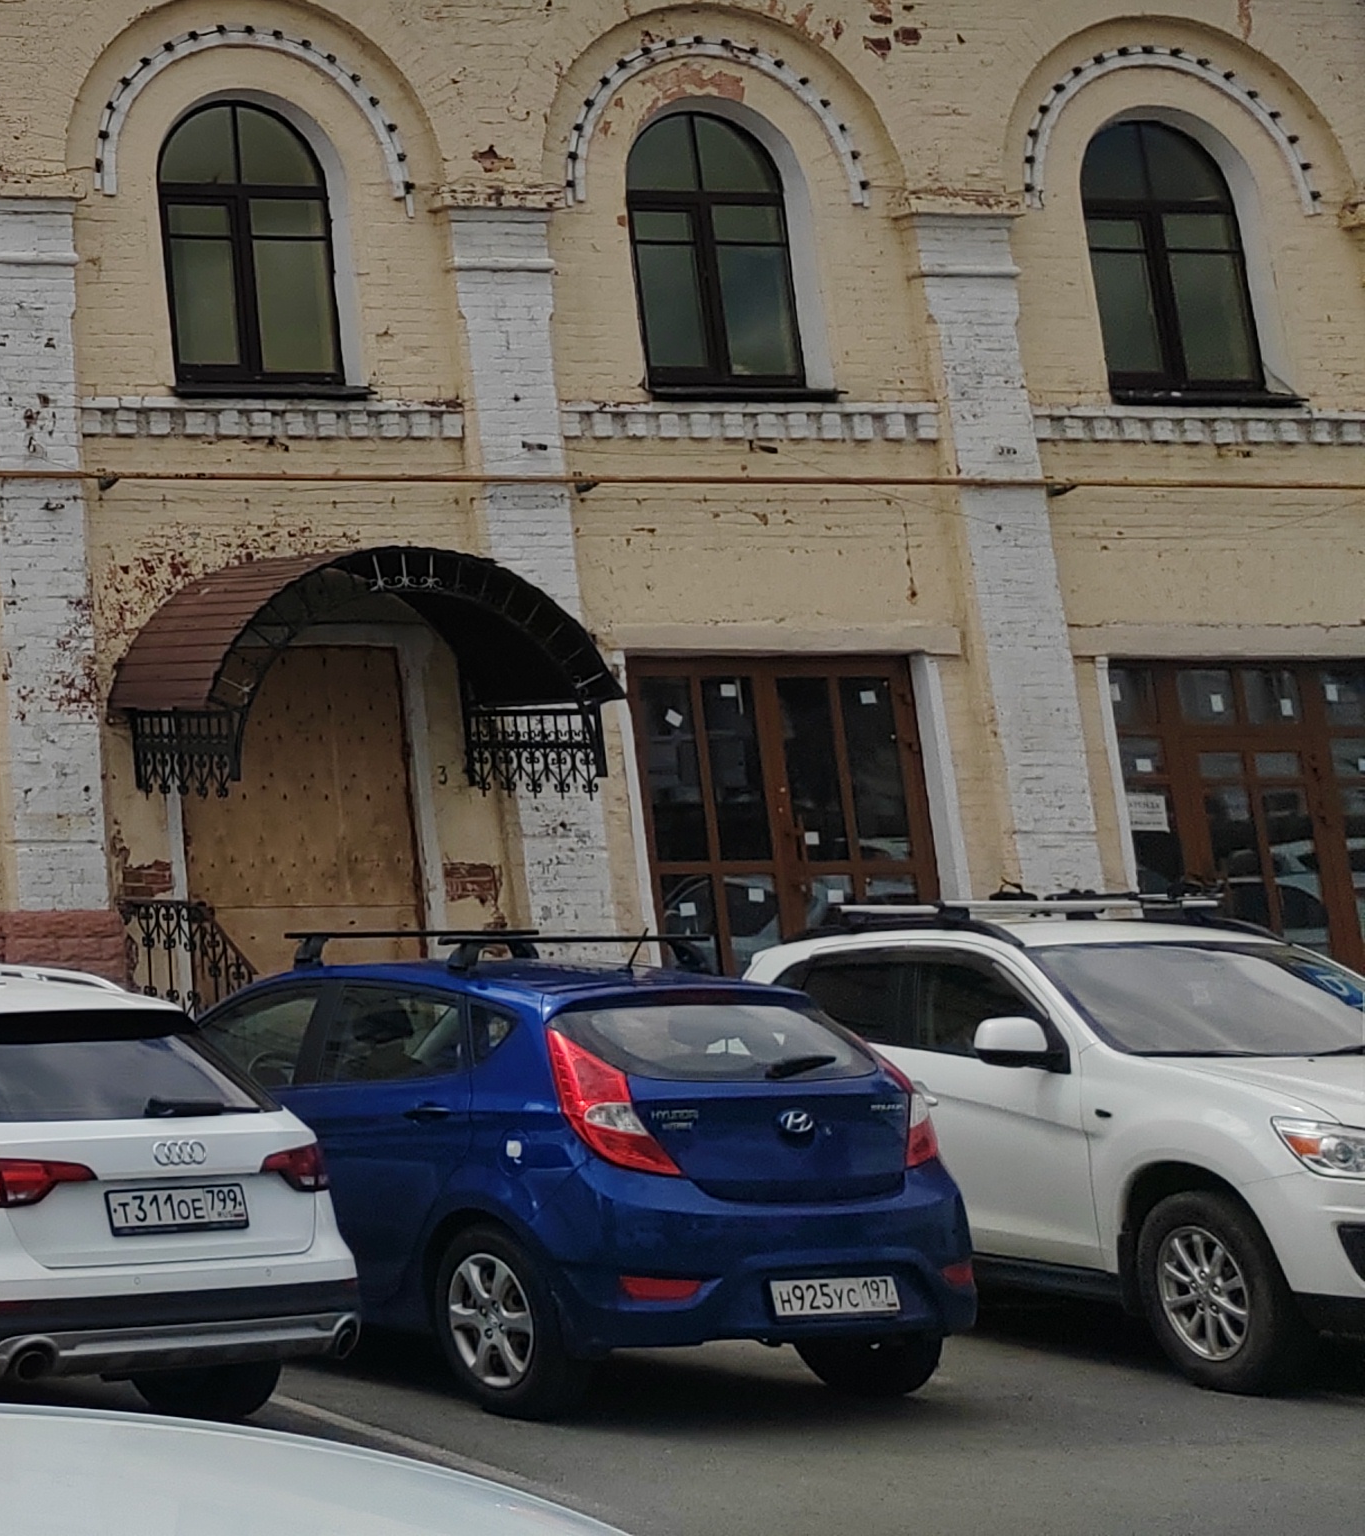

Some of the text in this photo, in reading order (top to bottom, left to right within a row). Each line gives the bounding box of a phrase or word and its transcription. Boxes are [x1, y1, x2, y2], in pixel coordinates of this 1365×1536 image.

[437, 765, 448, 785] 3
[206, 1188, 238, 1211] 799
[862, 1279, 889, 1300] 197
